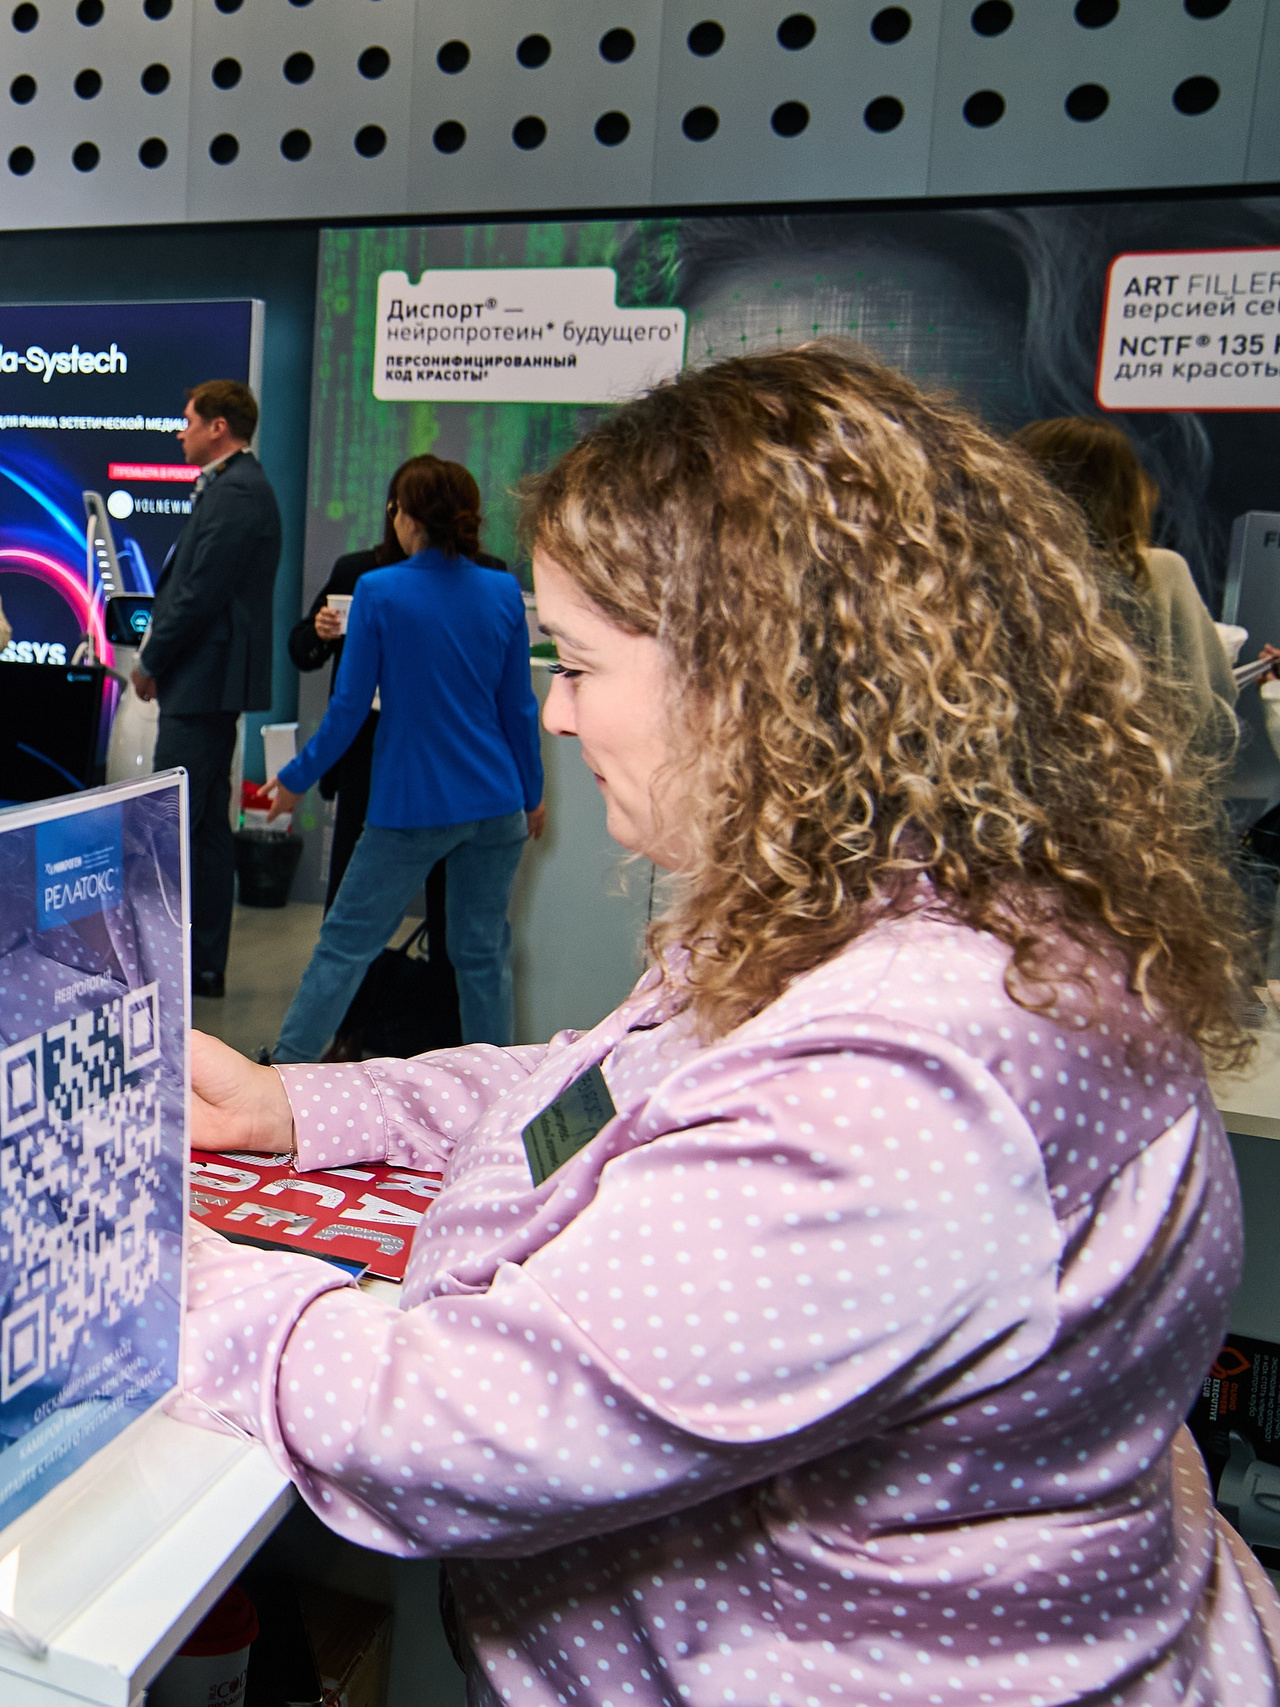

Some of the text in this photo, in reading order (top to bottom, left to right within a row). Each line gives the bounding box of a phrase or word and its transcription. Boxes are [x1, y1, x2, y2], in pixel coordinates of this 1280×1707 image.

[1124, 275, 1180, 297] ART
[1123, 296, 1236, 323] версией
[1218, 334, 1265, 356] 135
[386, 353, 577, 368] ПЕРСОНИФИЦИРОВАННЫЙ
[385, 370, 412, 382] КОД
[1114, 362, 1163, 382] для
[53, 969, 113, 1005] НЕВРОЛОГИЯ
[1202, 1377, 1210, 1398] CLUB
[1209, 1378, 1219, 1421] EXECUTIVE
